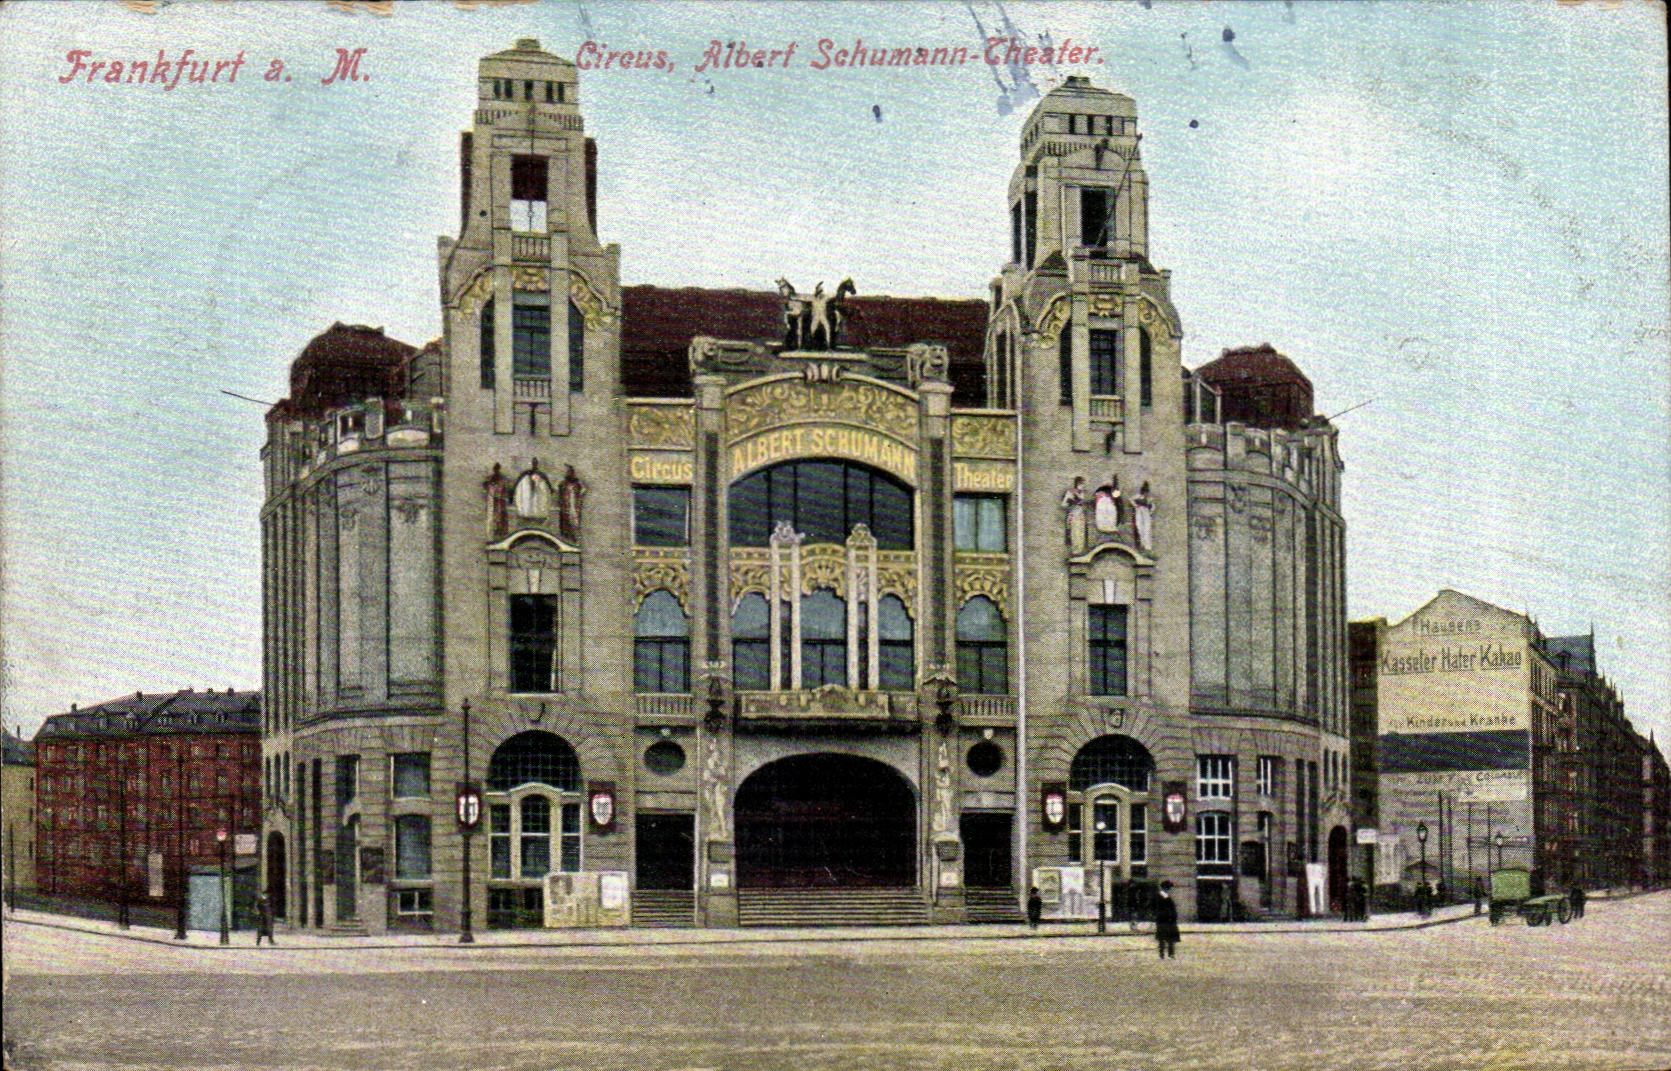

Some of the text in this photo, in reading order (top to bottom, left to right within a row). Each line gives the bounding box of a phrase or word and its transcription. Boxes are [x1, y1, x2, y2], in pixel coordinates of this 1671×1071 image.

[631, 453, 693, 480] Circus
[732, 427, 917, 479] ALBERT SCHUMANN
[953, 462, 1014, 489] Theater
